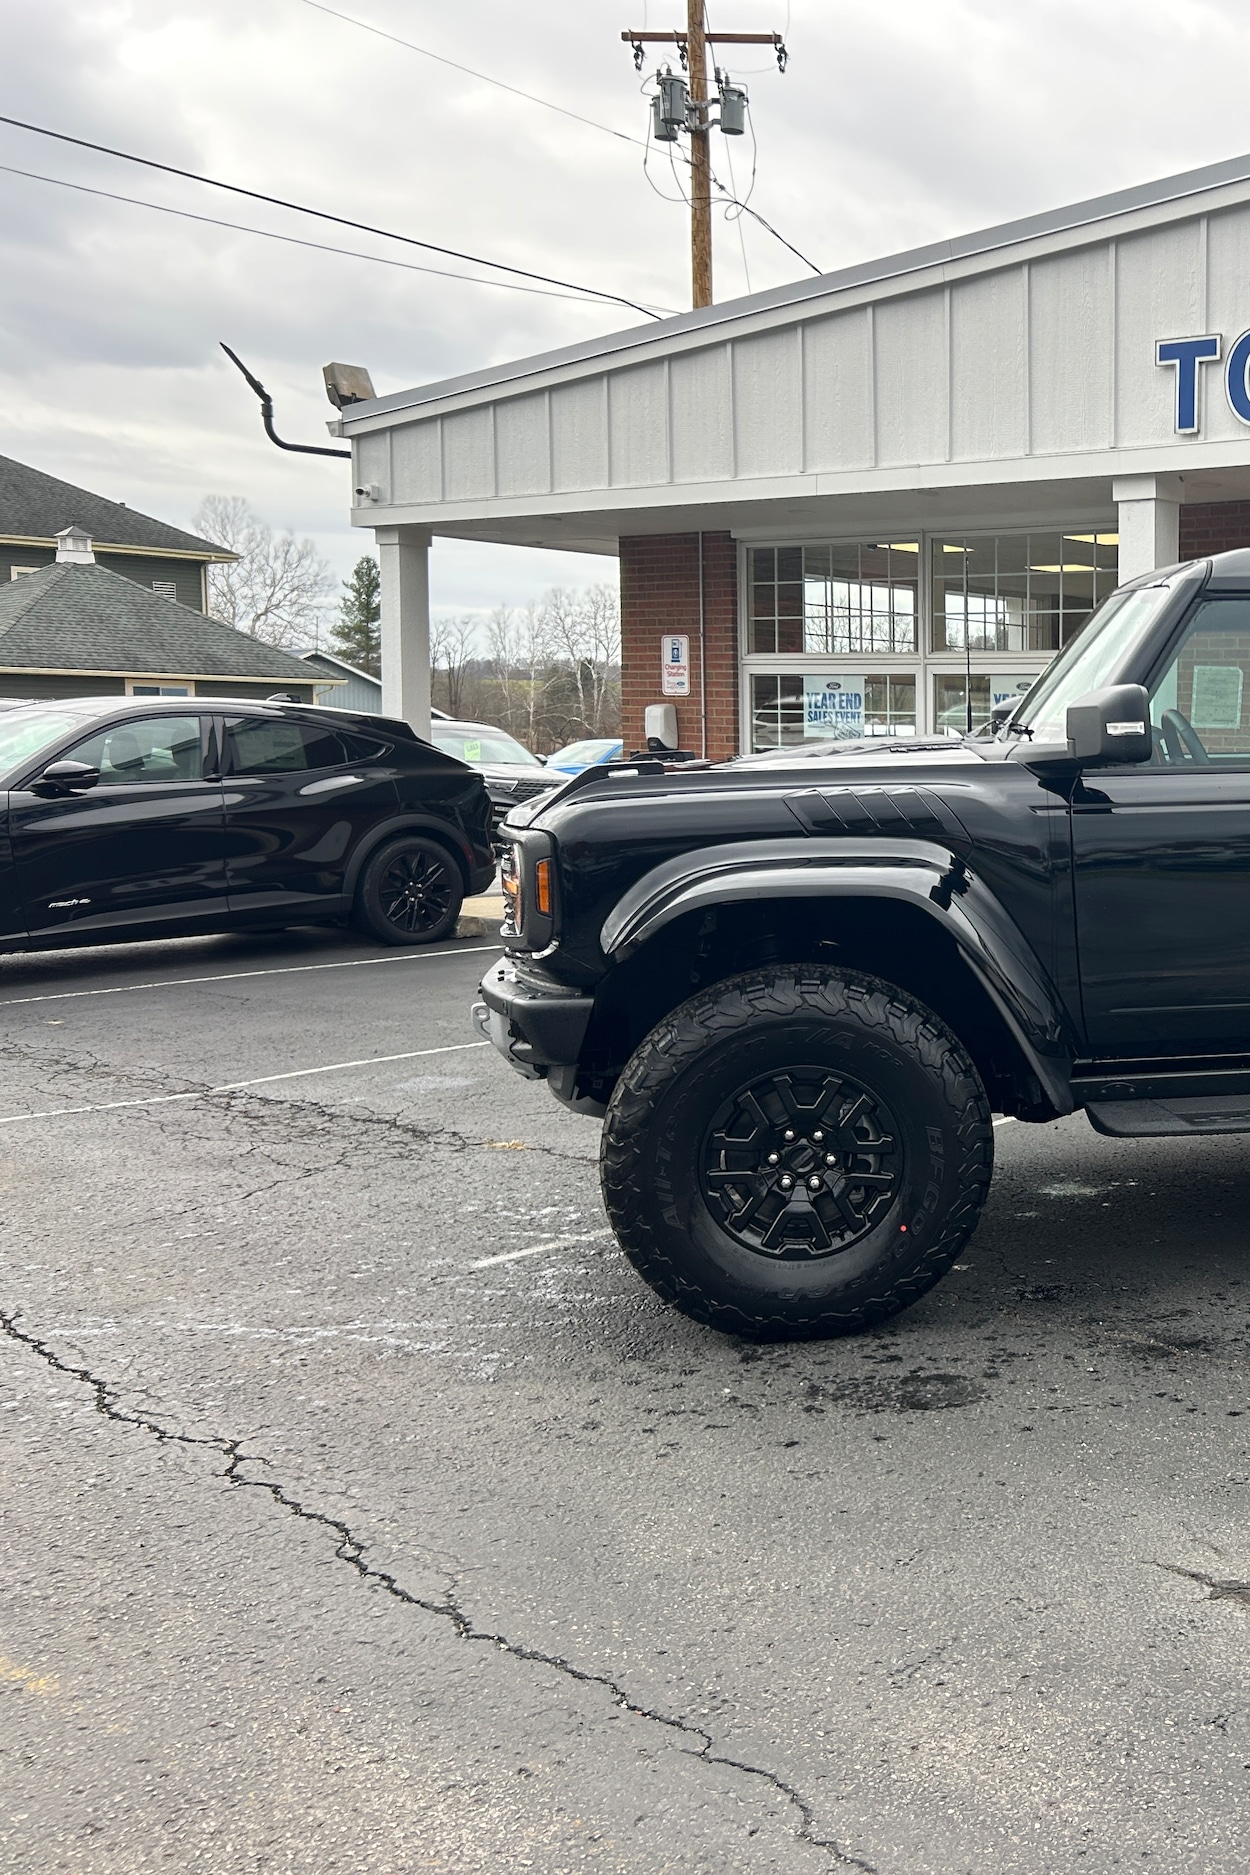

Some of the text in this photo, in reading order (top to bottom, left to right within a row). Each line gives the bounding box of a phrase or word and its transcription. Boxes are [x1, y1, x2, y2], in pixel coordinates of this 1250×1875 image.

[806, 692, 862, 709] YEAR END
[808, 711, 861, 723] SALES EVENT
